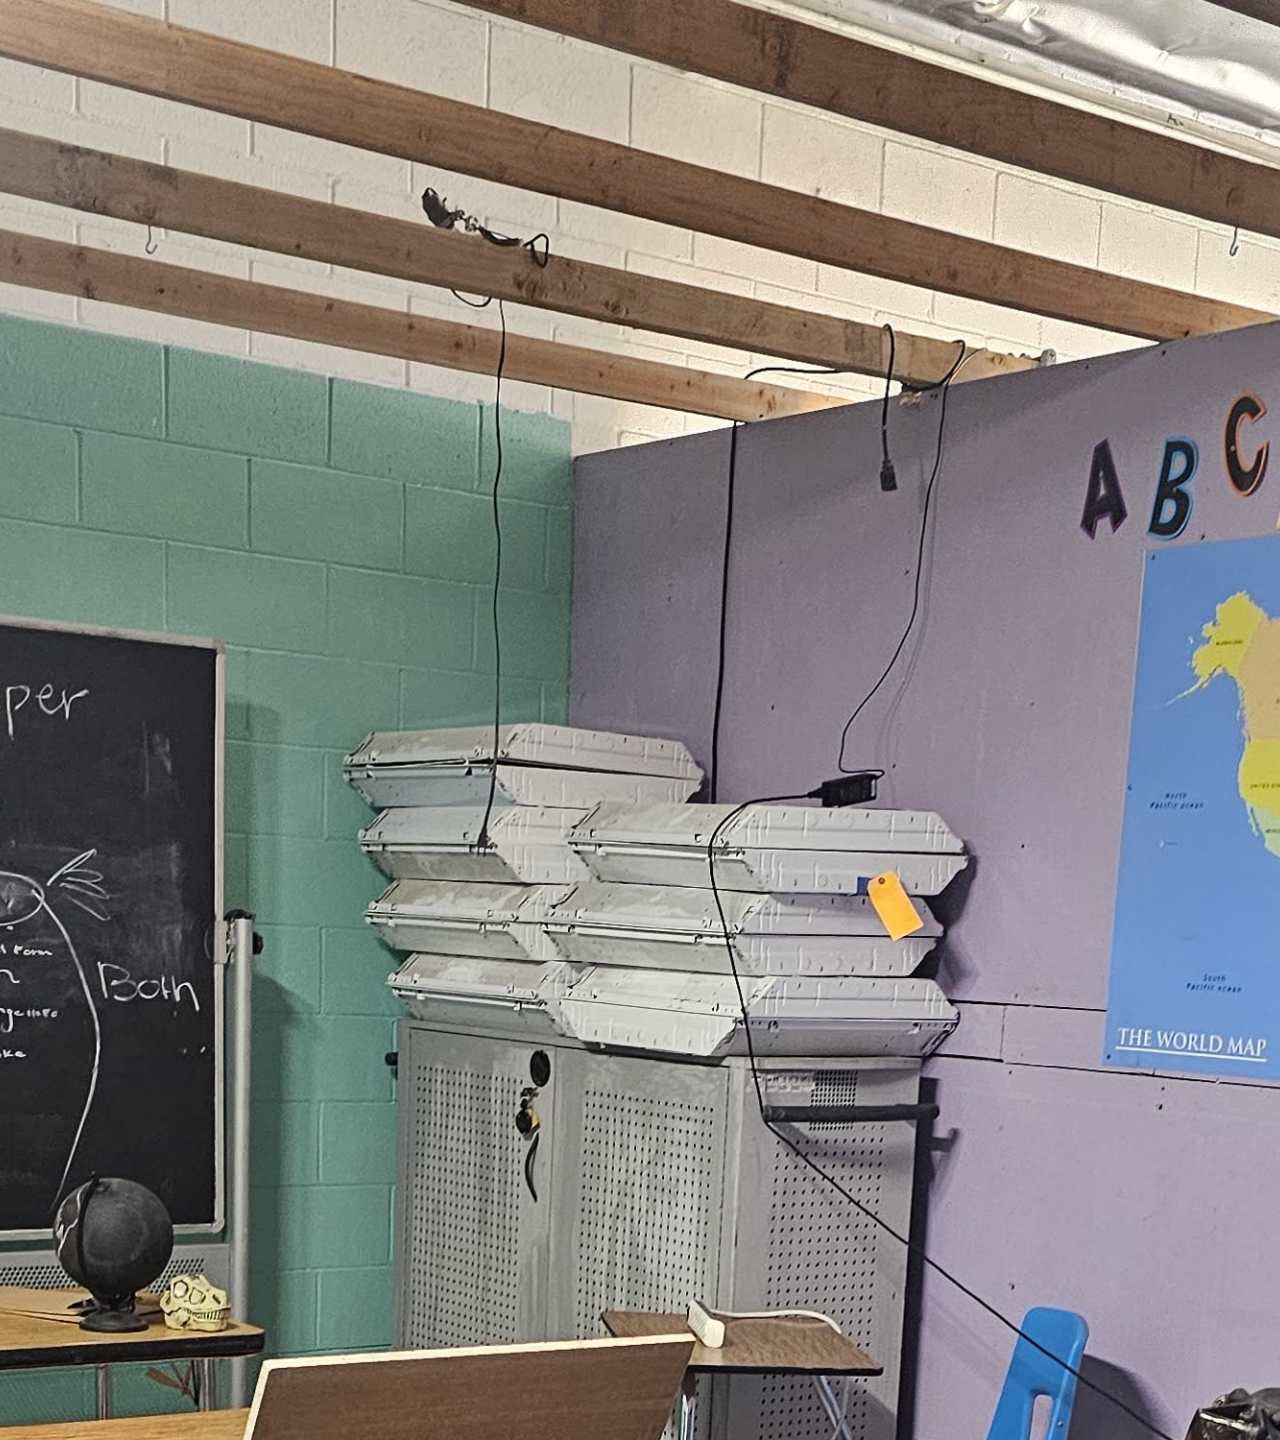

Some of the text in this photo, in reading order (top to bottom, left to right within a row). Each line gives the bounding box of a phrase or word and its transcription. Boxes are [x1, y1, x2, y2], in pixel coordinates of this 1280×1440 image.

[1079, 439, 1128, 540] A
[1147, 435, 1198, 541] B
[1223, 391, 1270, 497] C
[96, 960, 201, 1012] Both
[1117, 1026, 1267, 1057] THE WORLD MAP
